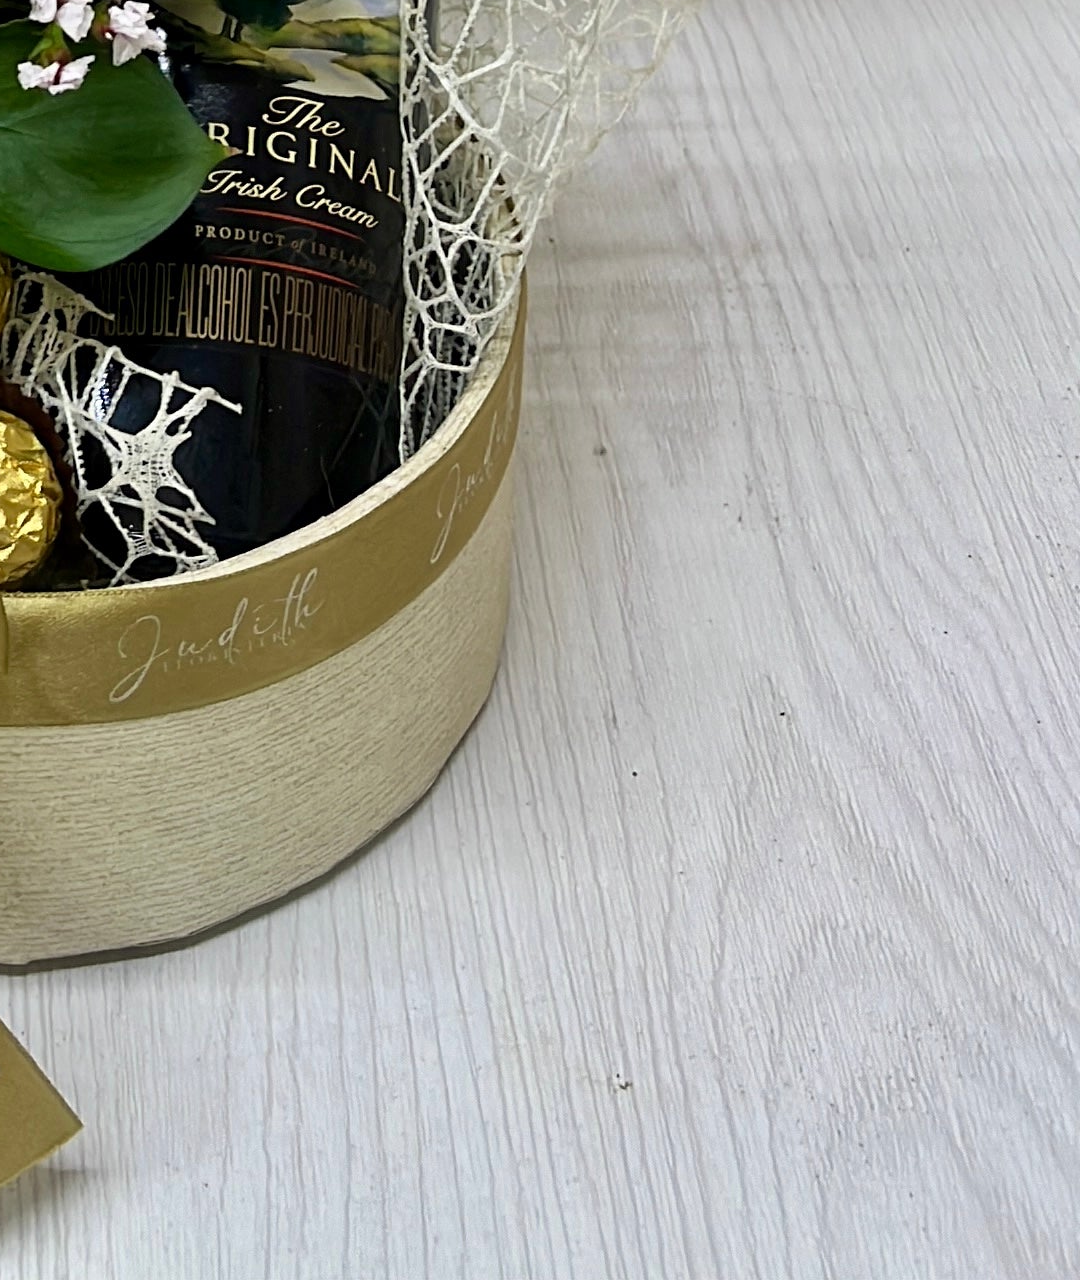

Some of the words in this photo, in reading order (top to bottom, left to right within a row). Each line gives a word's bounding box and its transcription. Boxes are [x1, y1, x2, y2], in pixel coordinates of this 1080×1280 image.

[261, 95, 346, 137] The
[207, 121, 402, 203] RIGINAL
[199, 169, 288, 201] Irish
[295, 183, 380, 229] Cream
[194, 224, 286, 247] PRODUCT
[176, 262, 255, 345] ALCOHOL
[258, 270, 281, 349] ES
[109, 567, 325, 703] Judith
